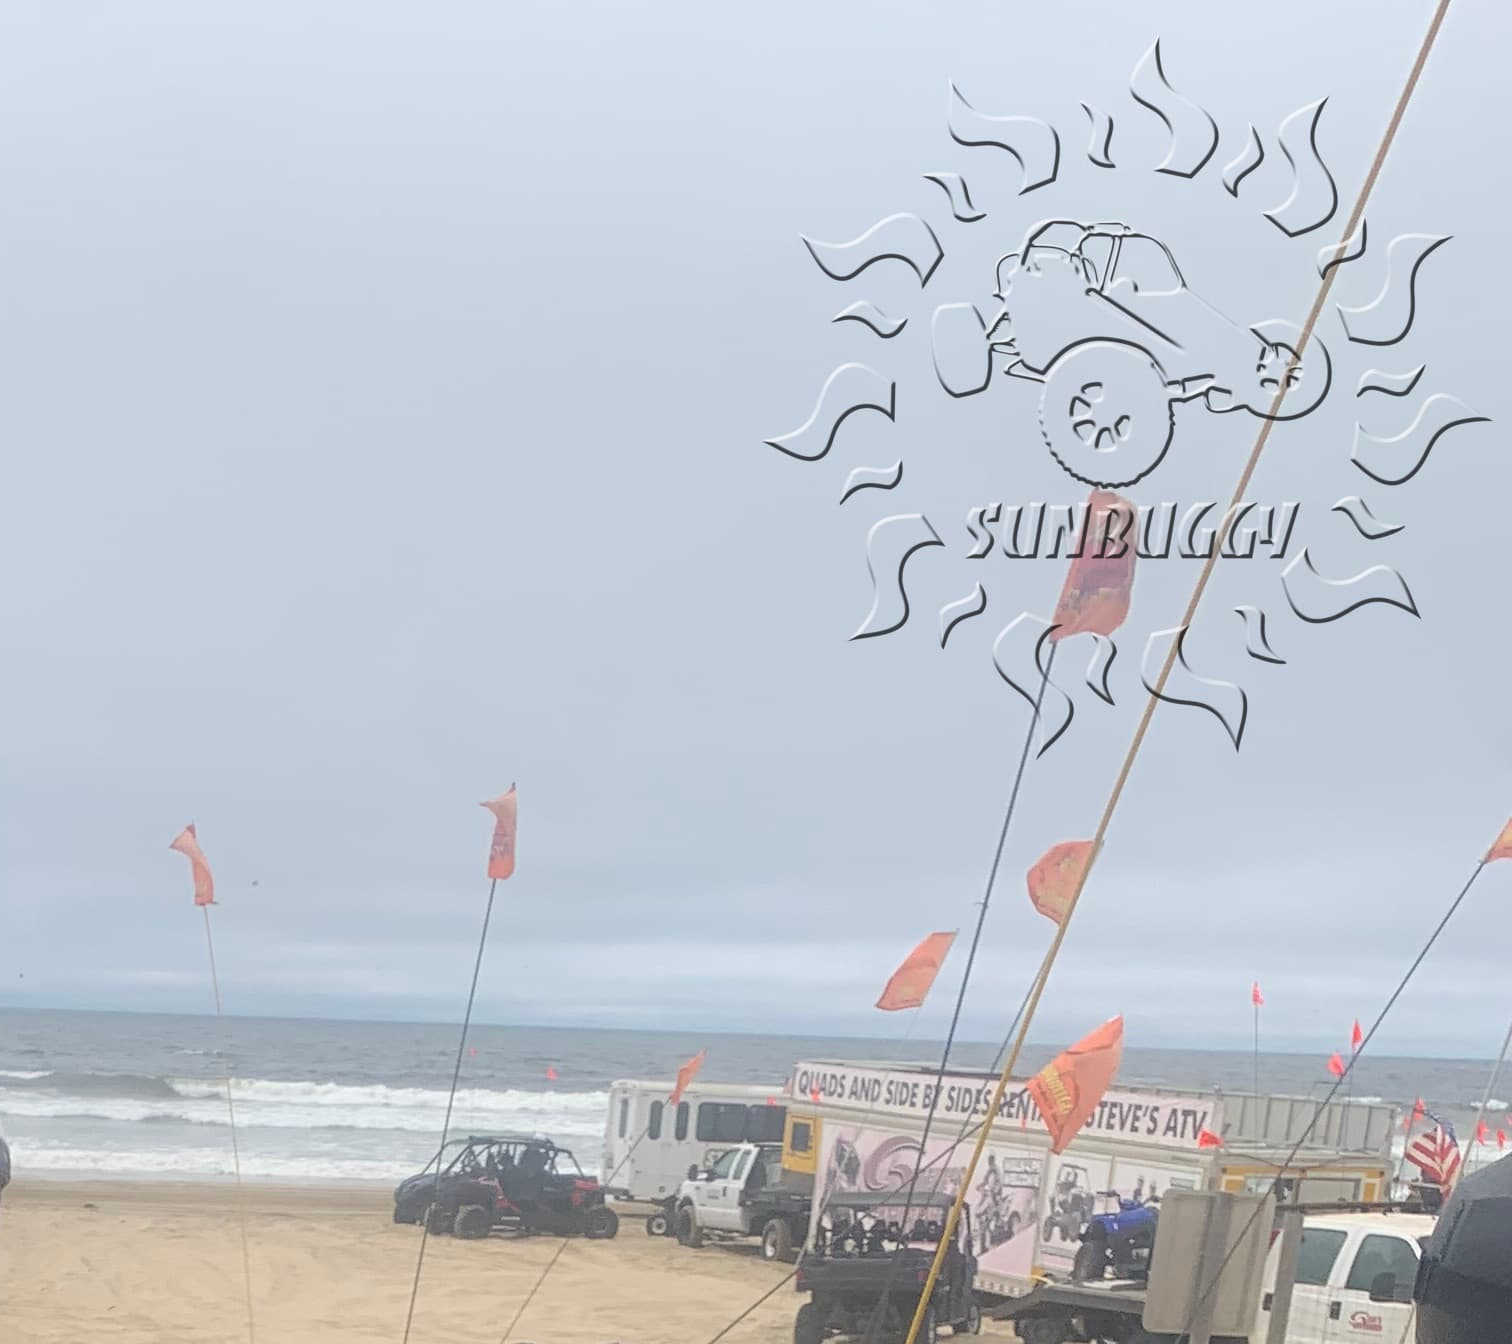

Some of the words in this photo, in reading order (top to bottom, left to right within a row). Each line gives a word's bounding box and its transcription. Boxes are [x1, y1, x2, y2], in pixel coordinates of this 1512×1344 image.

[799, 1070, 847, 1098] QUADS
[849, 1076, 881, 1102] AND
[886, 1080, 919, 1108] SIDE
[922, 1084, 944, 1110] BY
[945, 1086, 992, 1115] SIDES
[1163, 1108, 1207, 1140] ATV
